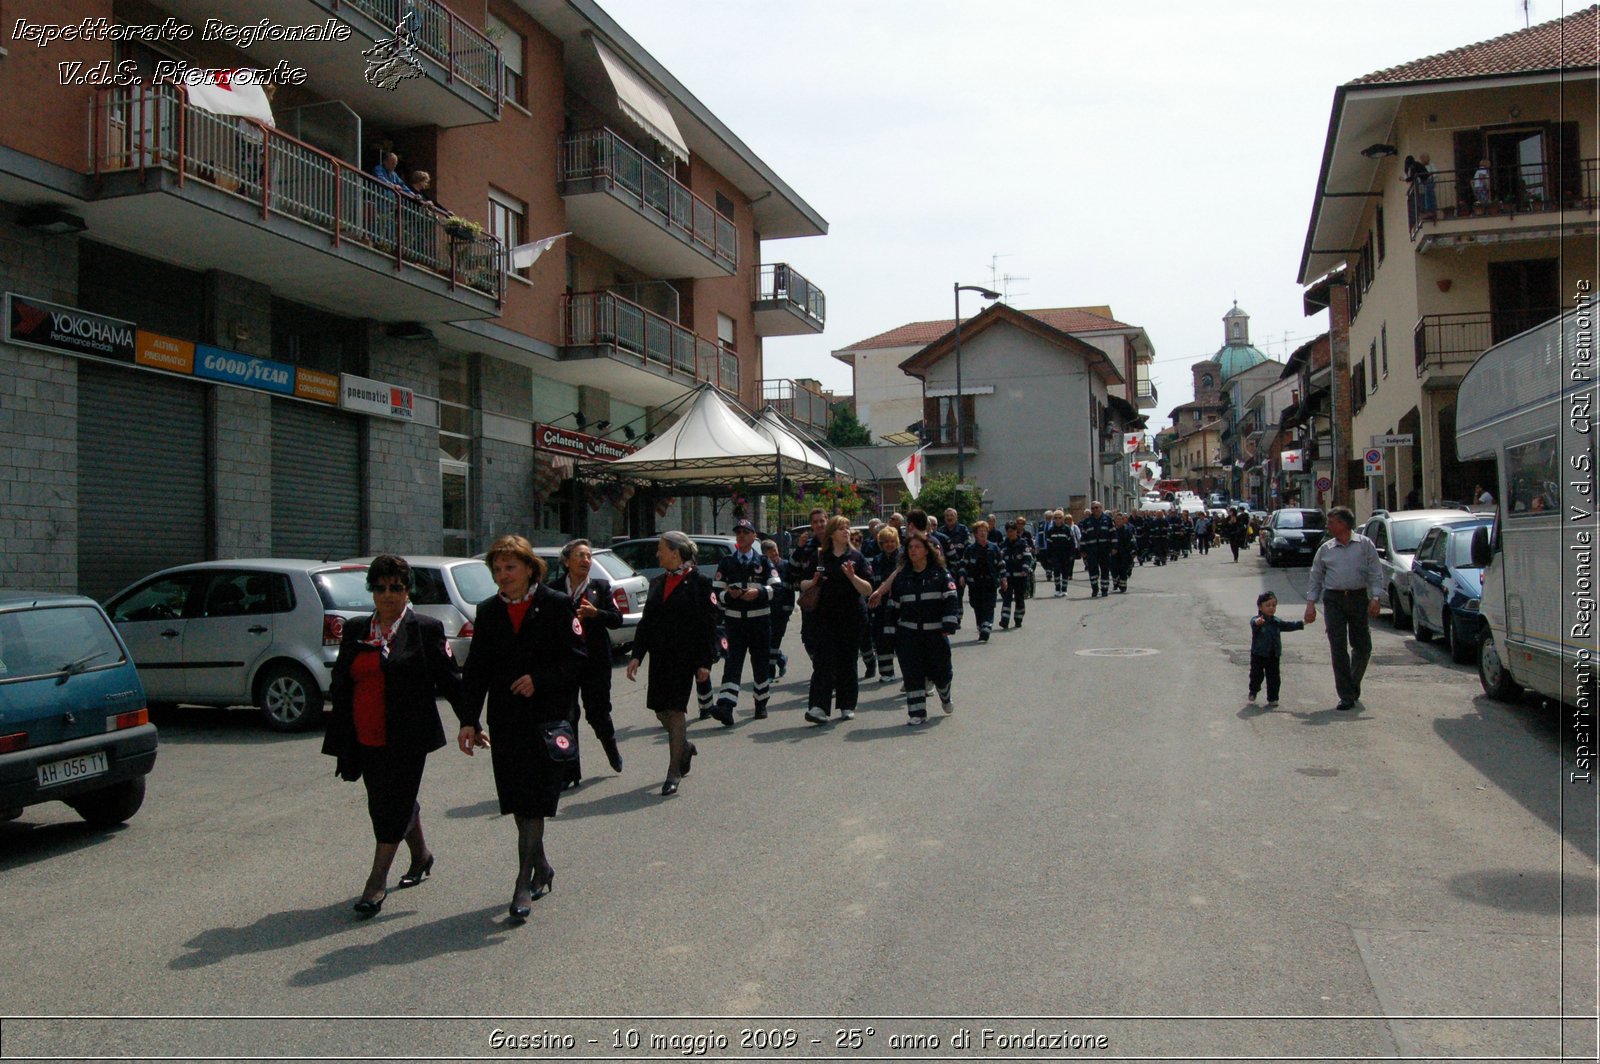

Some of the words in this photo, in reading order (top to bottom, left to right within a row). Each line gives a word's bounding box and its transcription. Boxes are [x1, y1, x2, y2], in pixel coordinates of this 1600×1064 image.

[51, 311, 134, 348] YOKOHAMA
[51, 331, 91, 348] Performance
[143, 350, 186, 367] PNEUMATICI
[203, 354, 289, 385] GOODYEAR
[347, 386, 389, 405] pneumatici
[543, 430, 584, 451] Gelateria
[41, 764, 58, 784] AH
[64, 759, 87, 778] 056
[92, 753, 105, 771] TY
